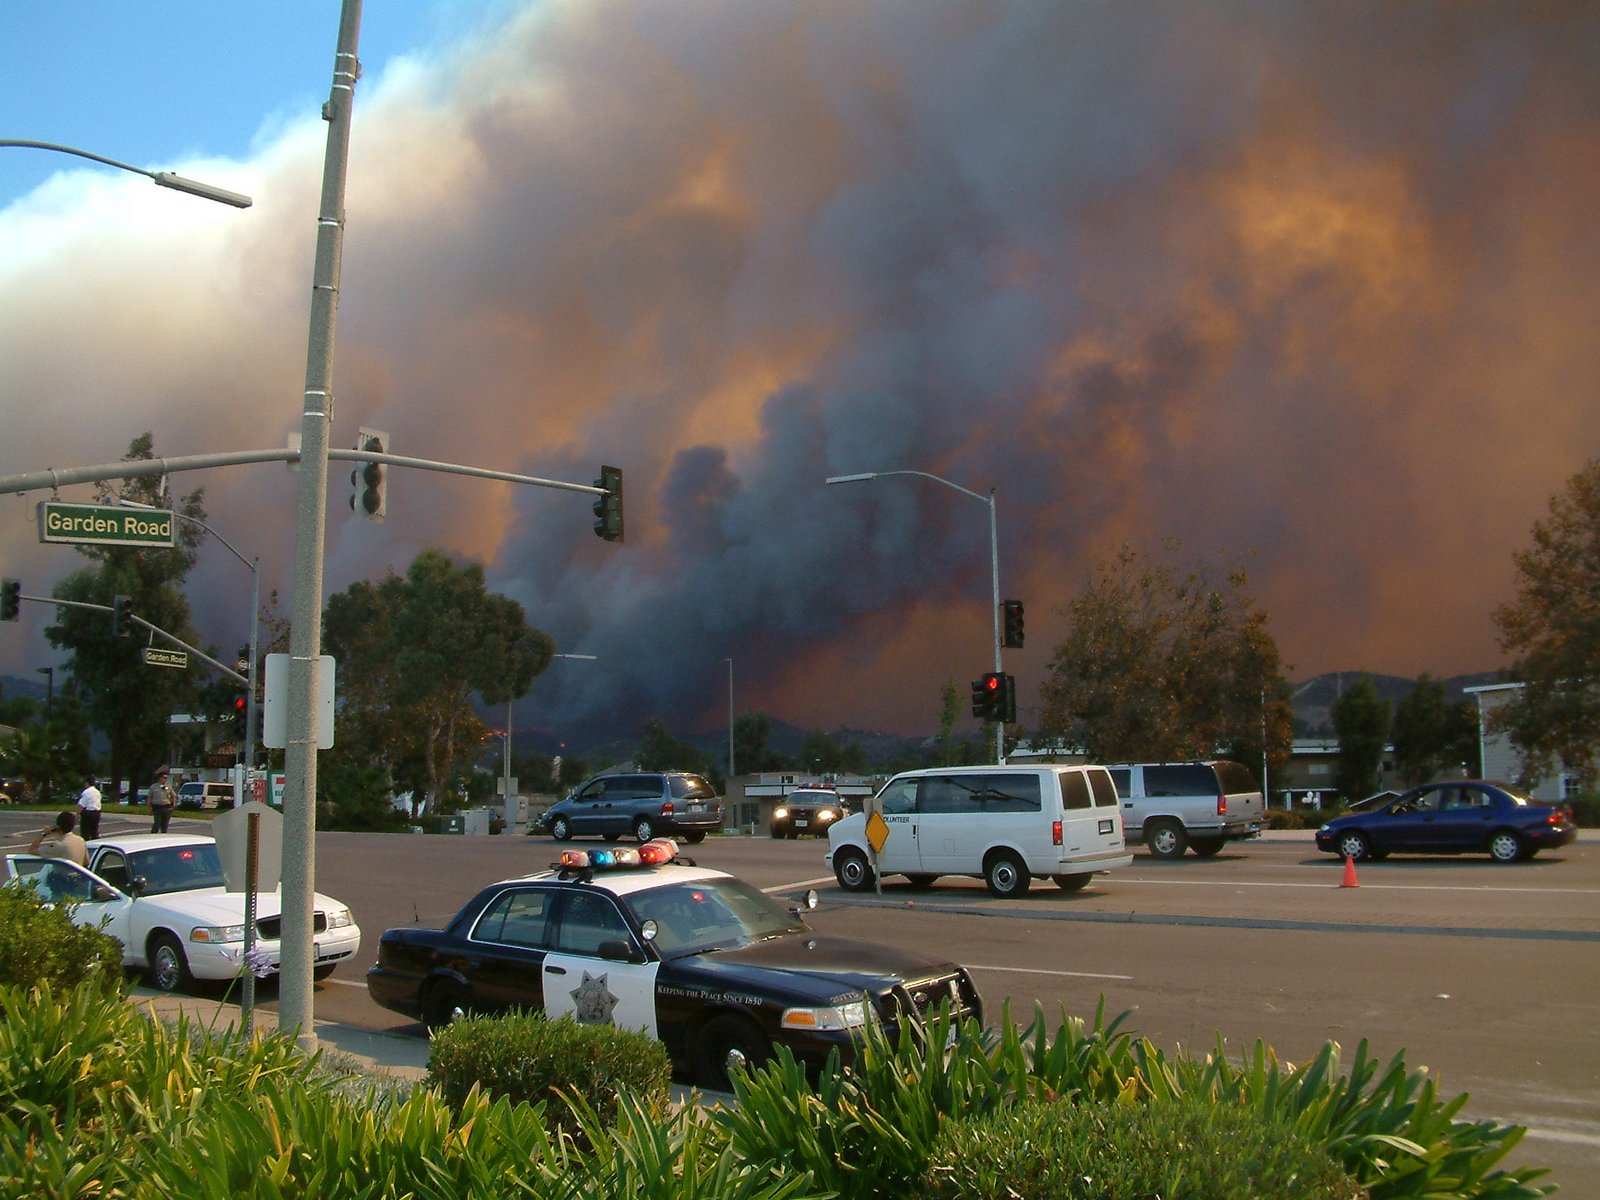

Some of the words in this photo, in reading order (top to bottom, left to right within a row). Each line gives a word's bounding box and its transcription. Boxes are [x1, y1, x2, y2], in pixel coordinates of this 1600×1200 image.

[48, 512, 118, 533] Garden
[124, 517, 171, 536] Road
[147, 652, 170, 662] Garden
[170, 655, 187, 664] Road
[745, 996, 763, 1006] 1850
